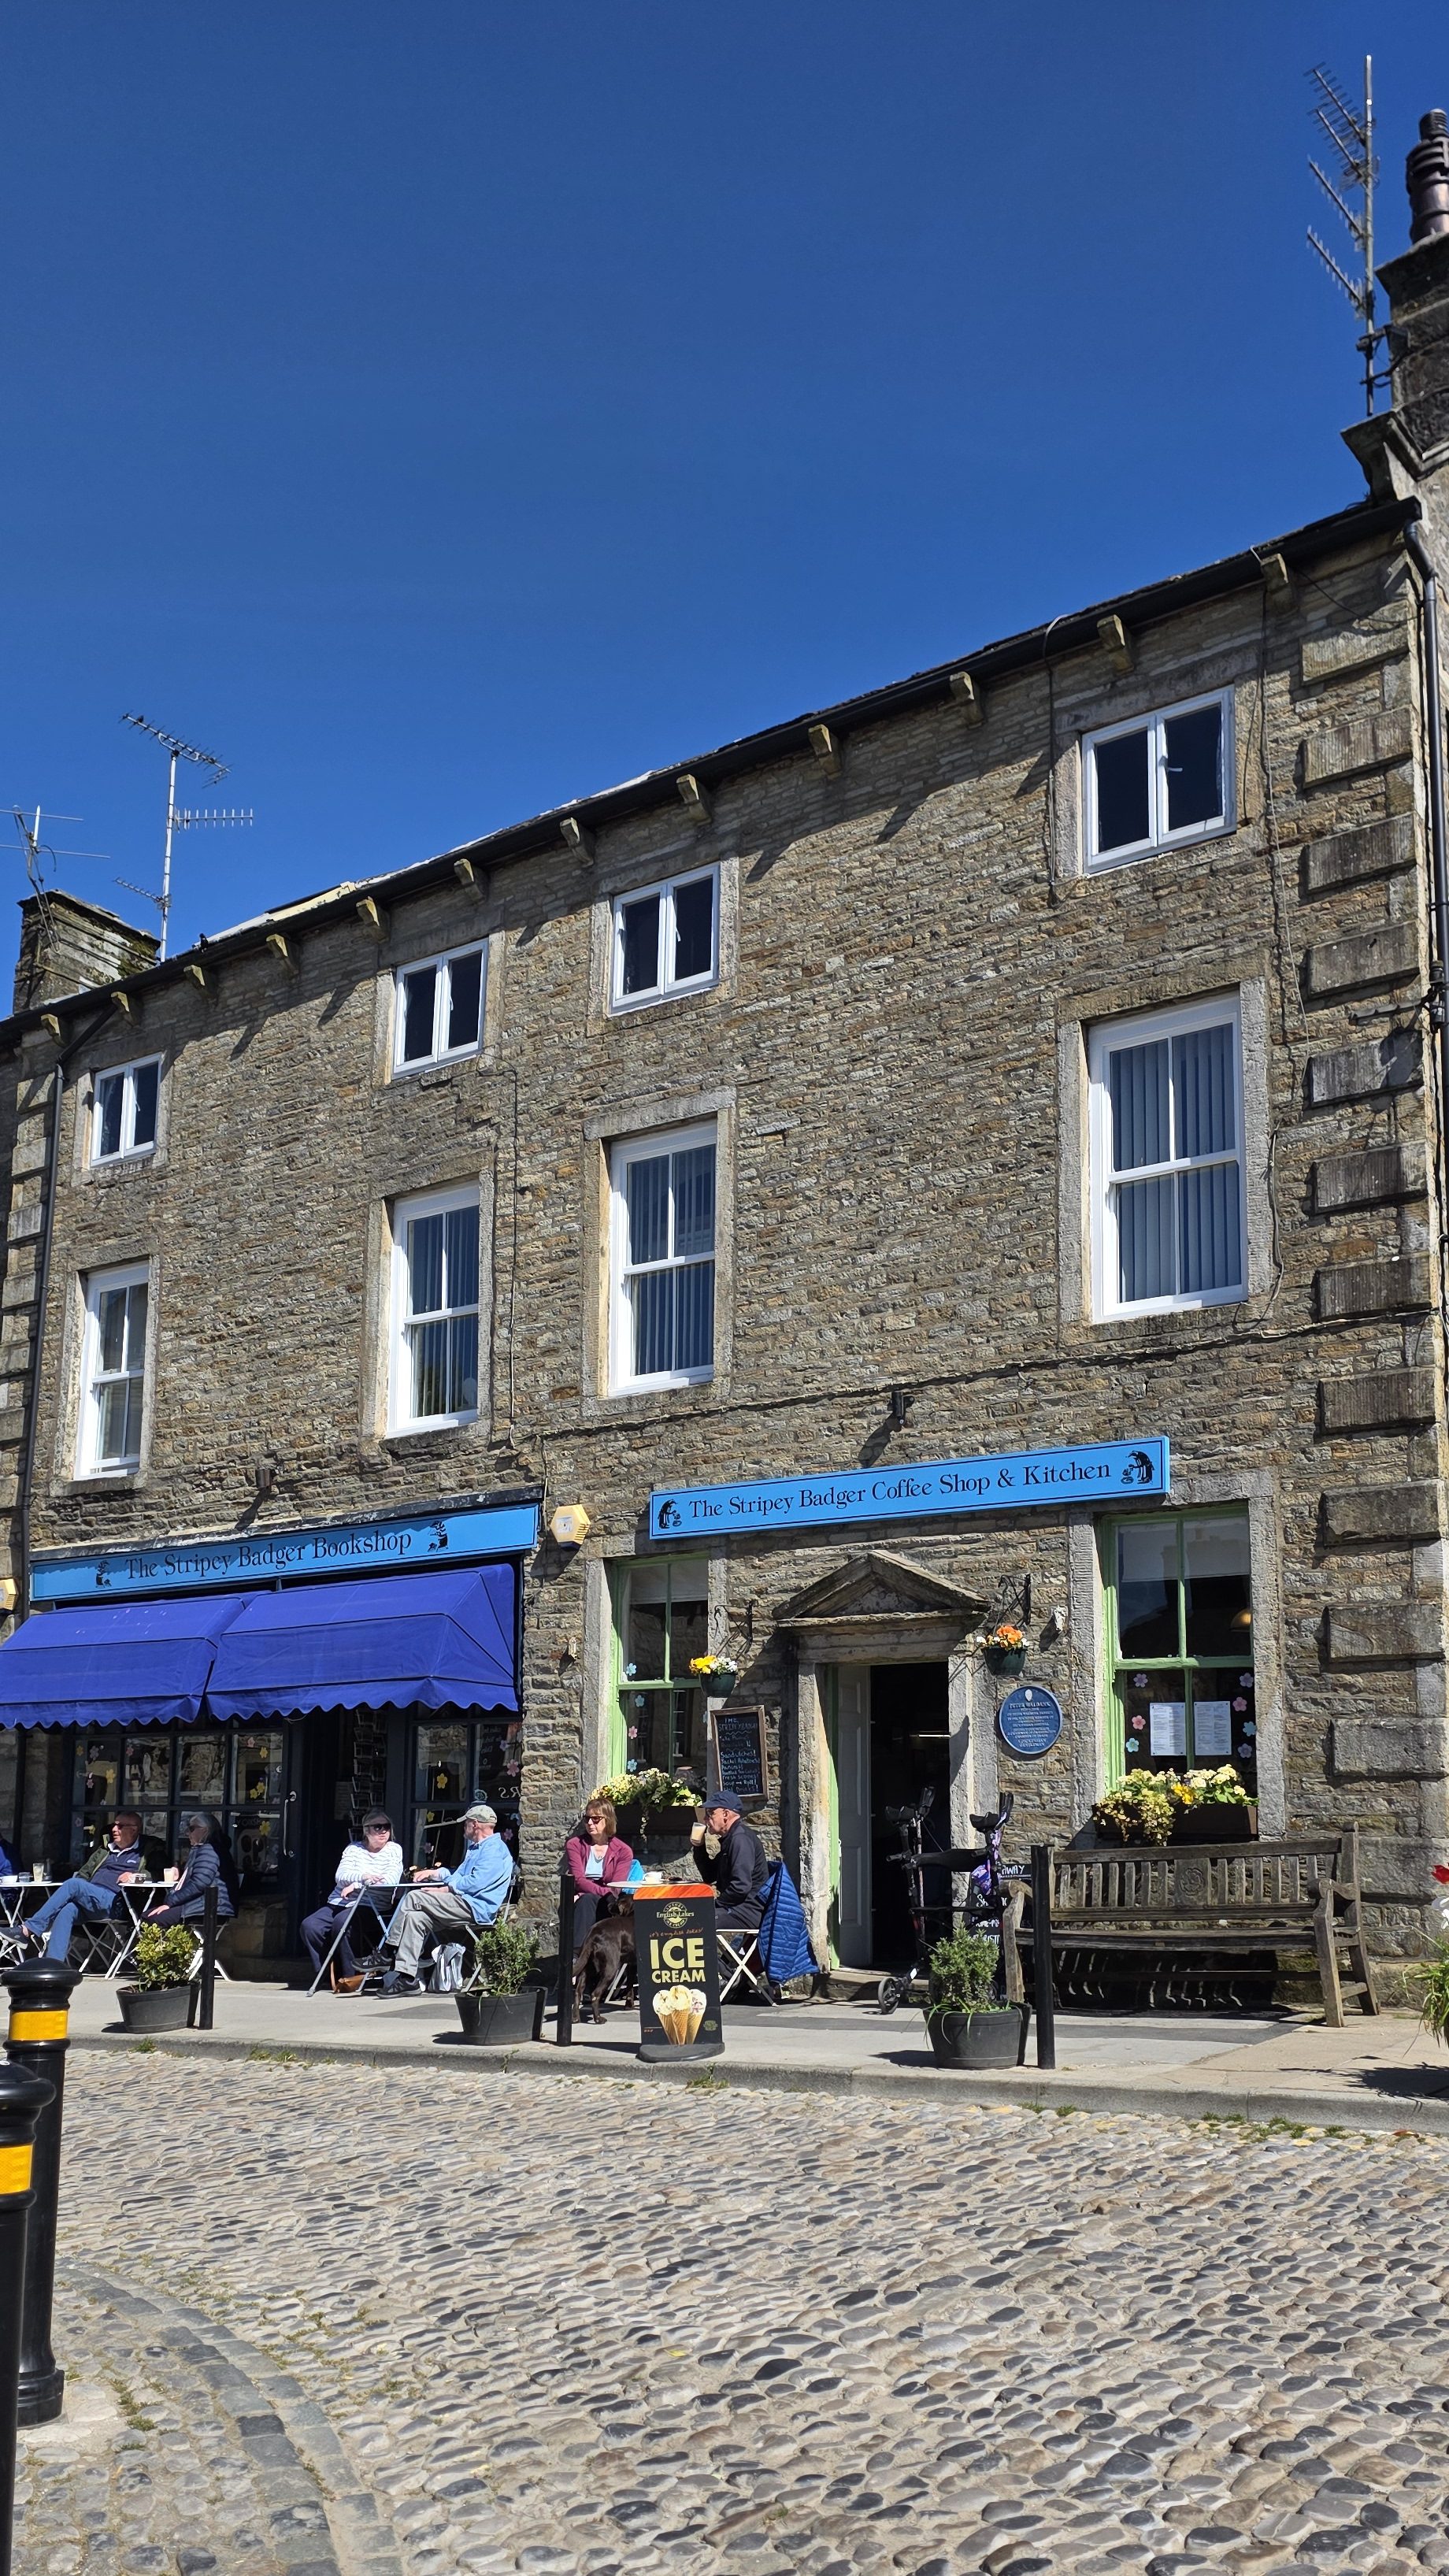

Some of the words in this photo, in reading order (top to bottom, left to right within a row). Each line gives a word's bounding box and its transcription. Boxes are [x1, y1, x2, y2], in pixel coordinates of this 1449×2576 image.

[688, 1499, 723, 1518] The
[728, 1496, 795, 1516] Stripey
[799, 1486, 866, 1510] Badger
[872, 1477, 933, 1500] Coffee
[939, 1473, 991, 1496] Shop
[997, 1468, 1017, 1488] &
[1022, 1461, 1112, 1486] Kitchen
[125, 1558, 158, 1580] The
[164, 1553, 232, 1577] Stripey
[238, 1542, 306, 1570] Badger
[312, 1529, 412, 1559] Bookshop
[656, 1911, 677, 1920] English
[650, 1937, 705, 1970] ICE
[651, 1969, 706, 1984] CREAM
